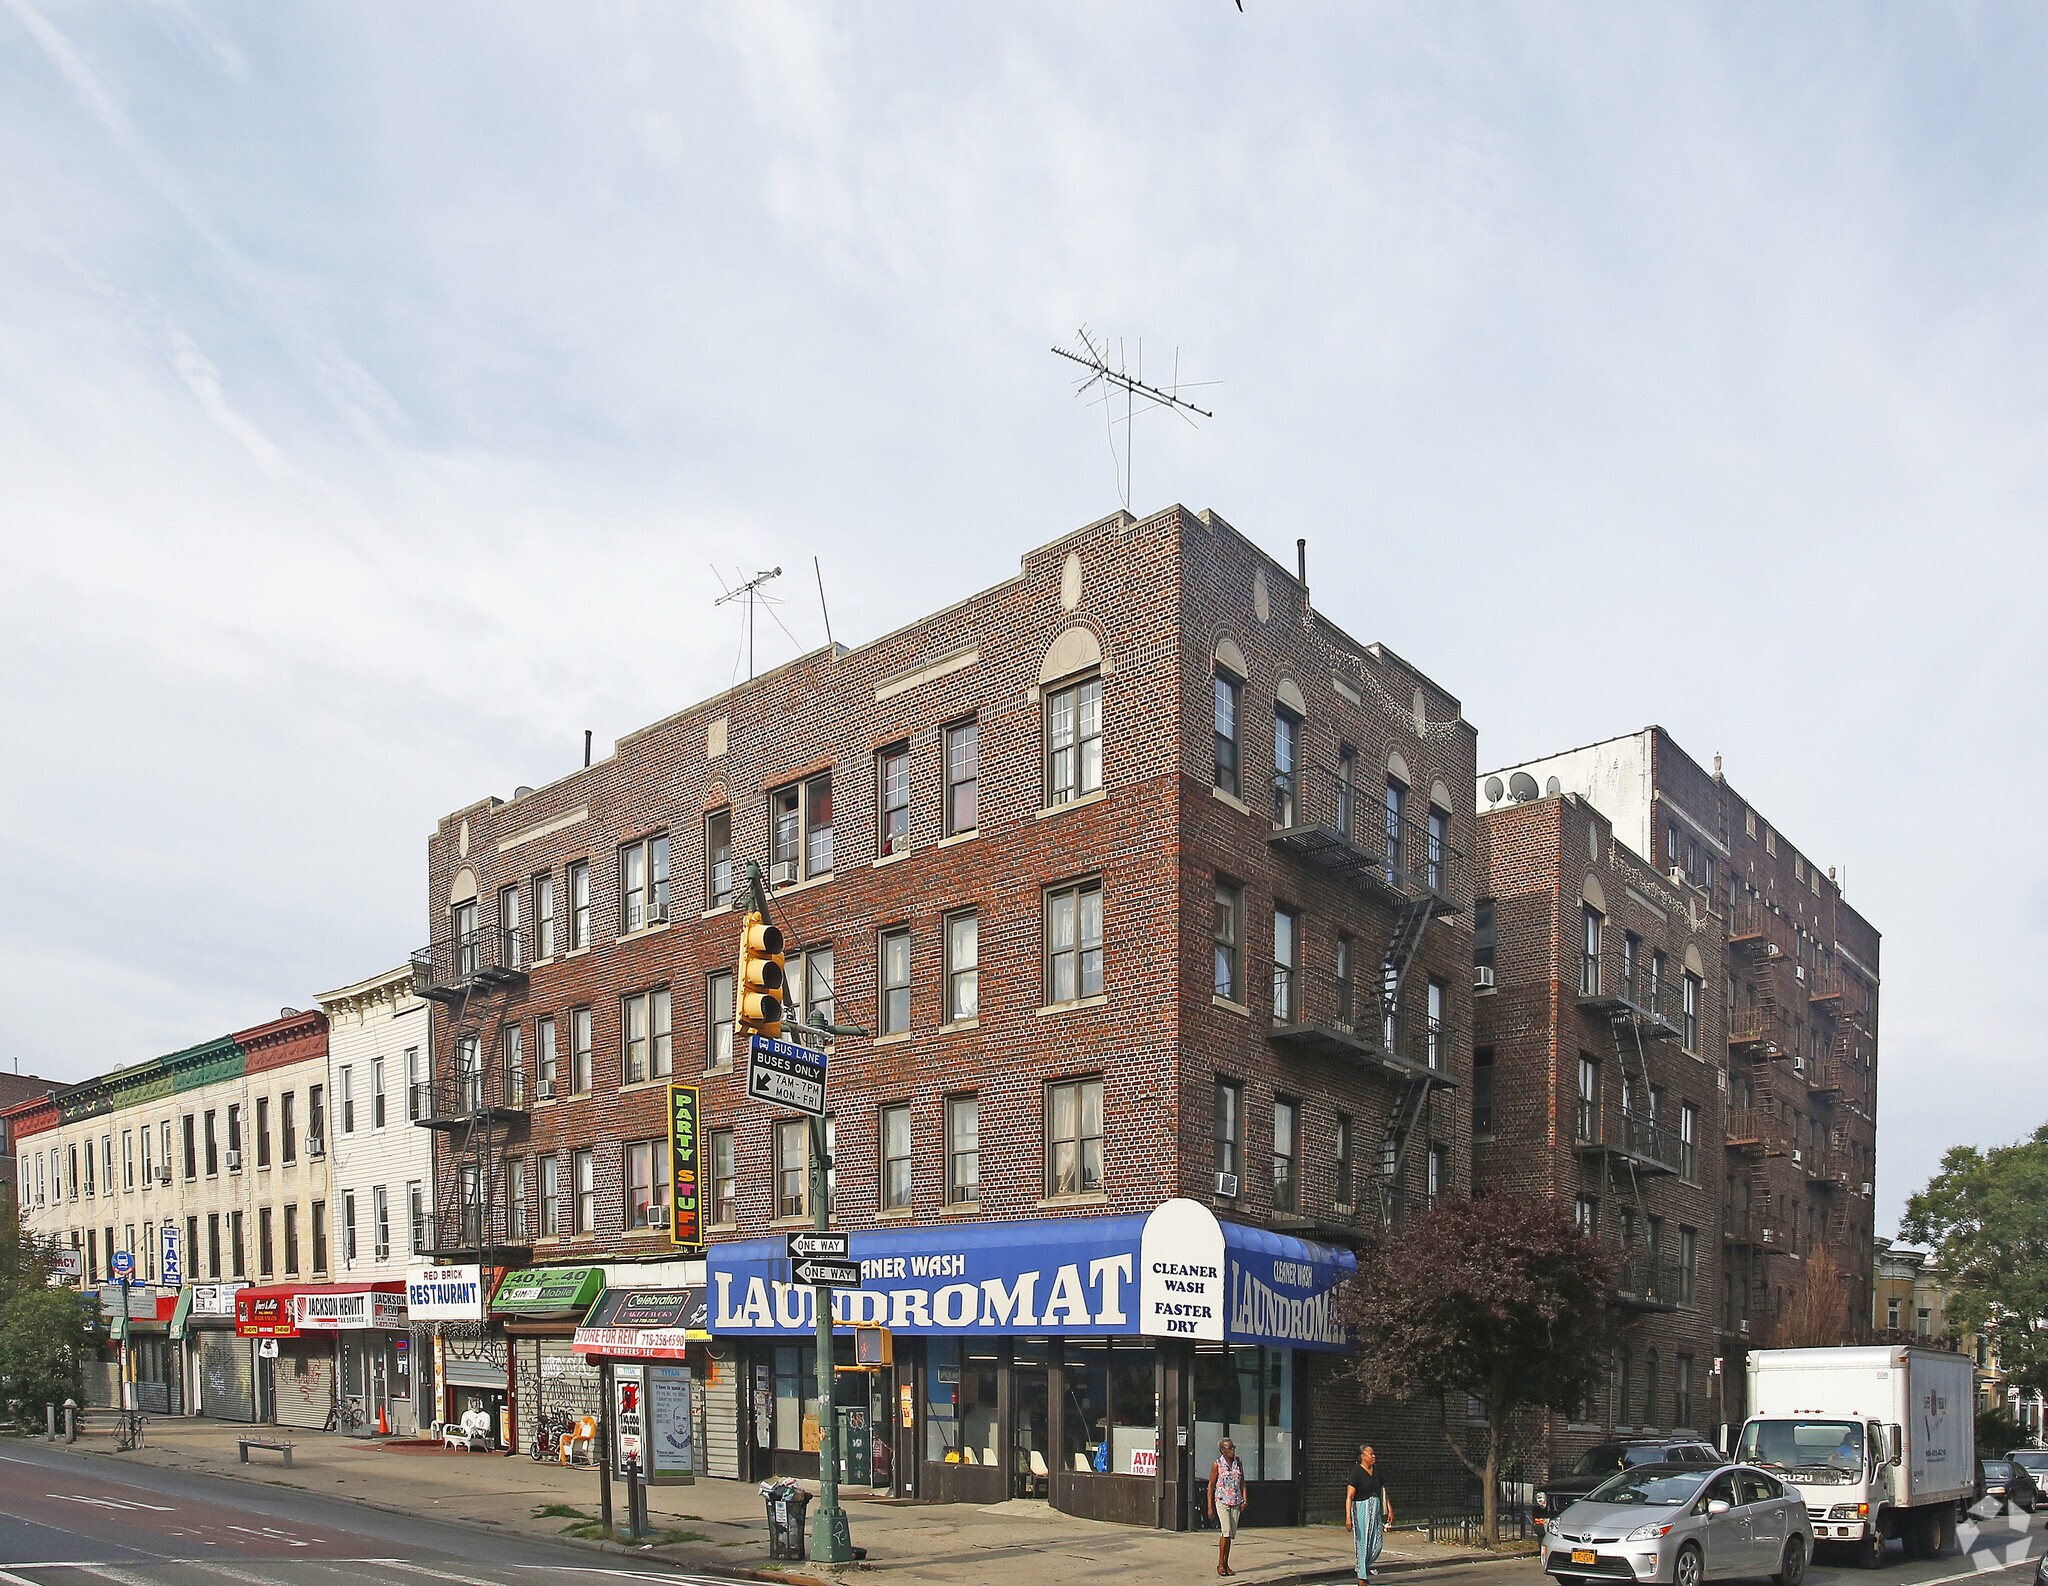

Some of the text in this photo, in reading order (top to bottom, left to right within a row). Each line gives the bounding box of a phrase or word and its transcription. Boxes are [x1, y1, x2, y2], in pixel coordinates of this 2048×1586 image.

[774, 1042, 820, 1065] BUS LANE
[757, 1052, 820, 1079] BUSES ONLY
[775, 1087, 795, 1101] MON
[803, 1094, 817, 1107] FRI
[676, 1094, 694, 1161] PARTY
[677, 1169, 696, 1238] STUFF
[797, 1240, 841, 1251] ONE WAY
[164, 1236, 179, 1273] TAX
[423, 1269, 463, 1280] RED BRICK
[804, 1267, 852, 1280] ONE WAY
[857, 1254, 965, 1281] ANER WASH
[1152, 1262, 1218, 1279] CLEANER
[1273, 1260, 1313, 1289] CLEANER WASH
[410, 1282, 477, 1305] RESTAURANT
[512, 1288, 573, 1299] SIMPLE Mobile
[714, 1253, 1133, 1328] LAUNDROMAT
[1164, 1280, 1205, 1294] WASH
[308, 1296, 365, 1316] JACKSON HEWITT
[374, 1294, 406, 1305] JACKSON
[627, 1293, 683, 1308] Celebration
[1154, 1302, 1212, 1319] FASTER
[347, 1316, 365, 1324] SERVICE
[1166, 1319, 1198, 1333] DRY
[575, 1328, 640, 1346] STORE FOR RENT
[641, 1333, 685, 1347] 718-258-6590
[613, 1347, 640, 1356] BROKERS
[642, 1348, 654, 1356] FEE
[660, 1369, 680, 1377] TITAN
